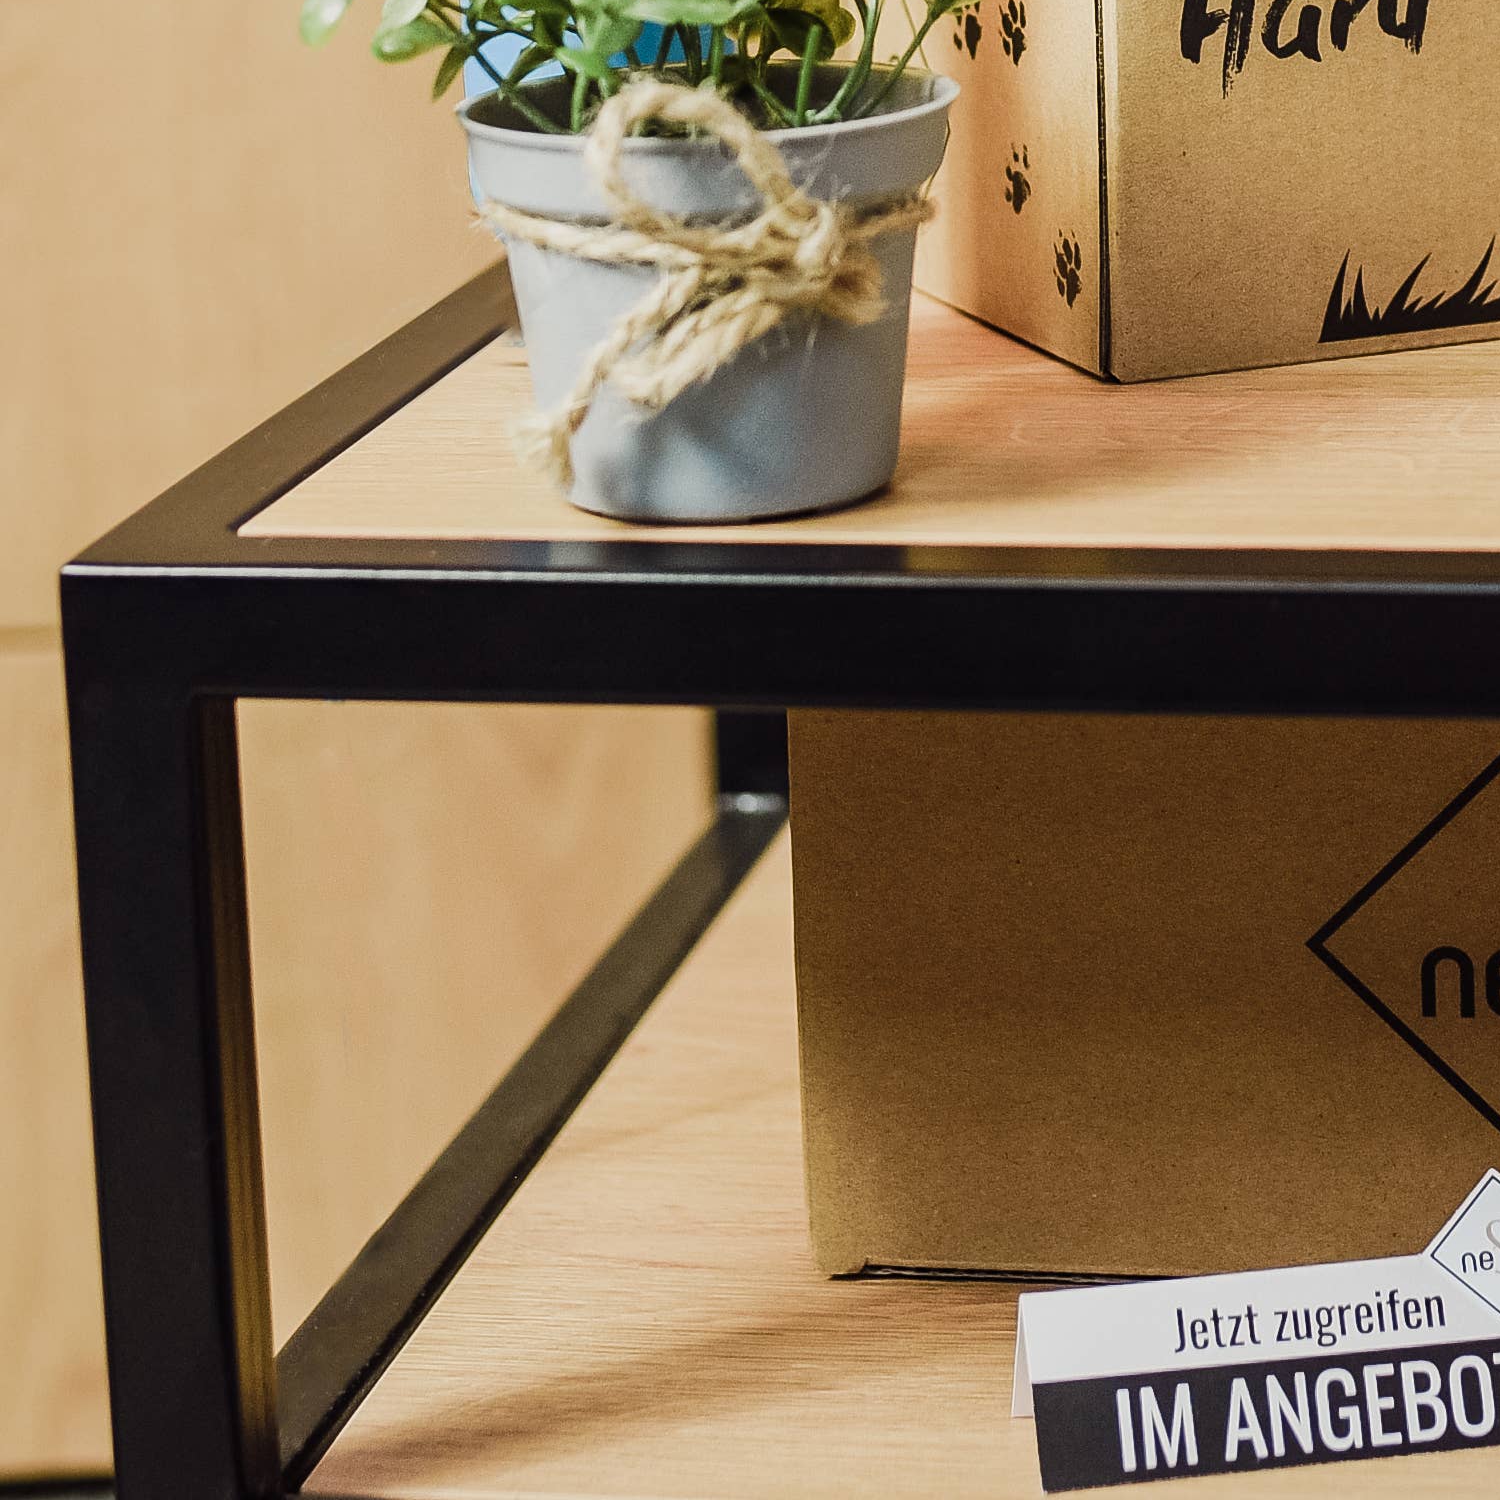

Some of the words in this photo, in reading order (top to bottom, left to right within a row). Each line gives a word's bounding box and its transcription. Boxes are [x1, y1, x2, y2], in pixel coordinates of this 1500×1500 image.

[1173, 1304, 1261, 1354] Jetzt
[1274, 1289, 1447, 1347] zugreifen
[1115, 1382, 1199, 1473] IM
